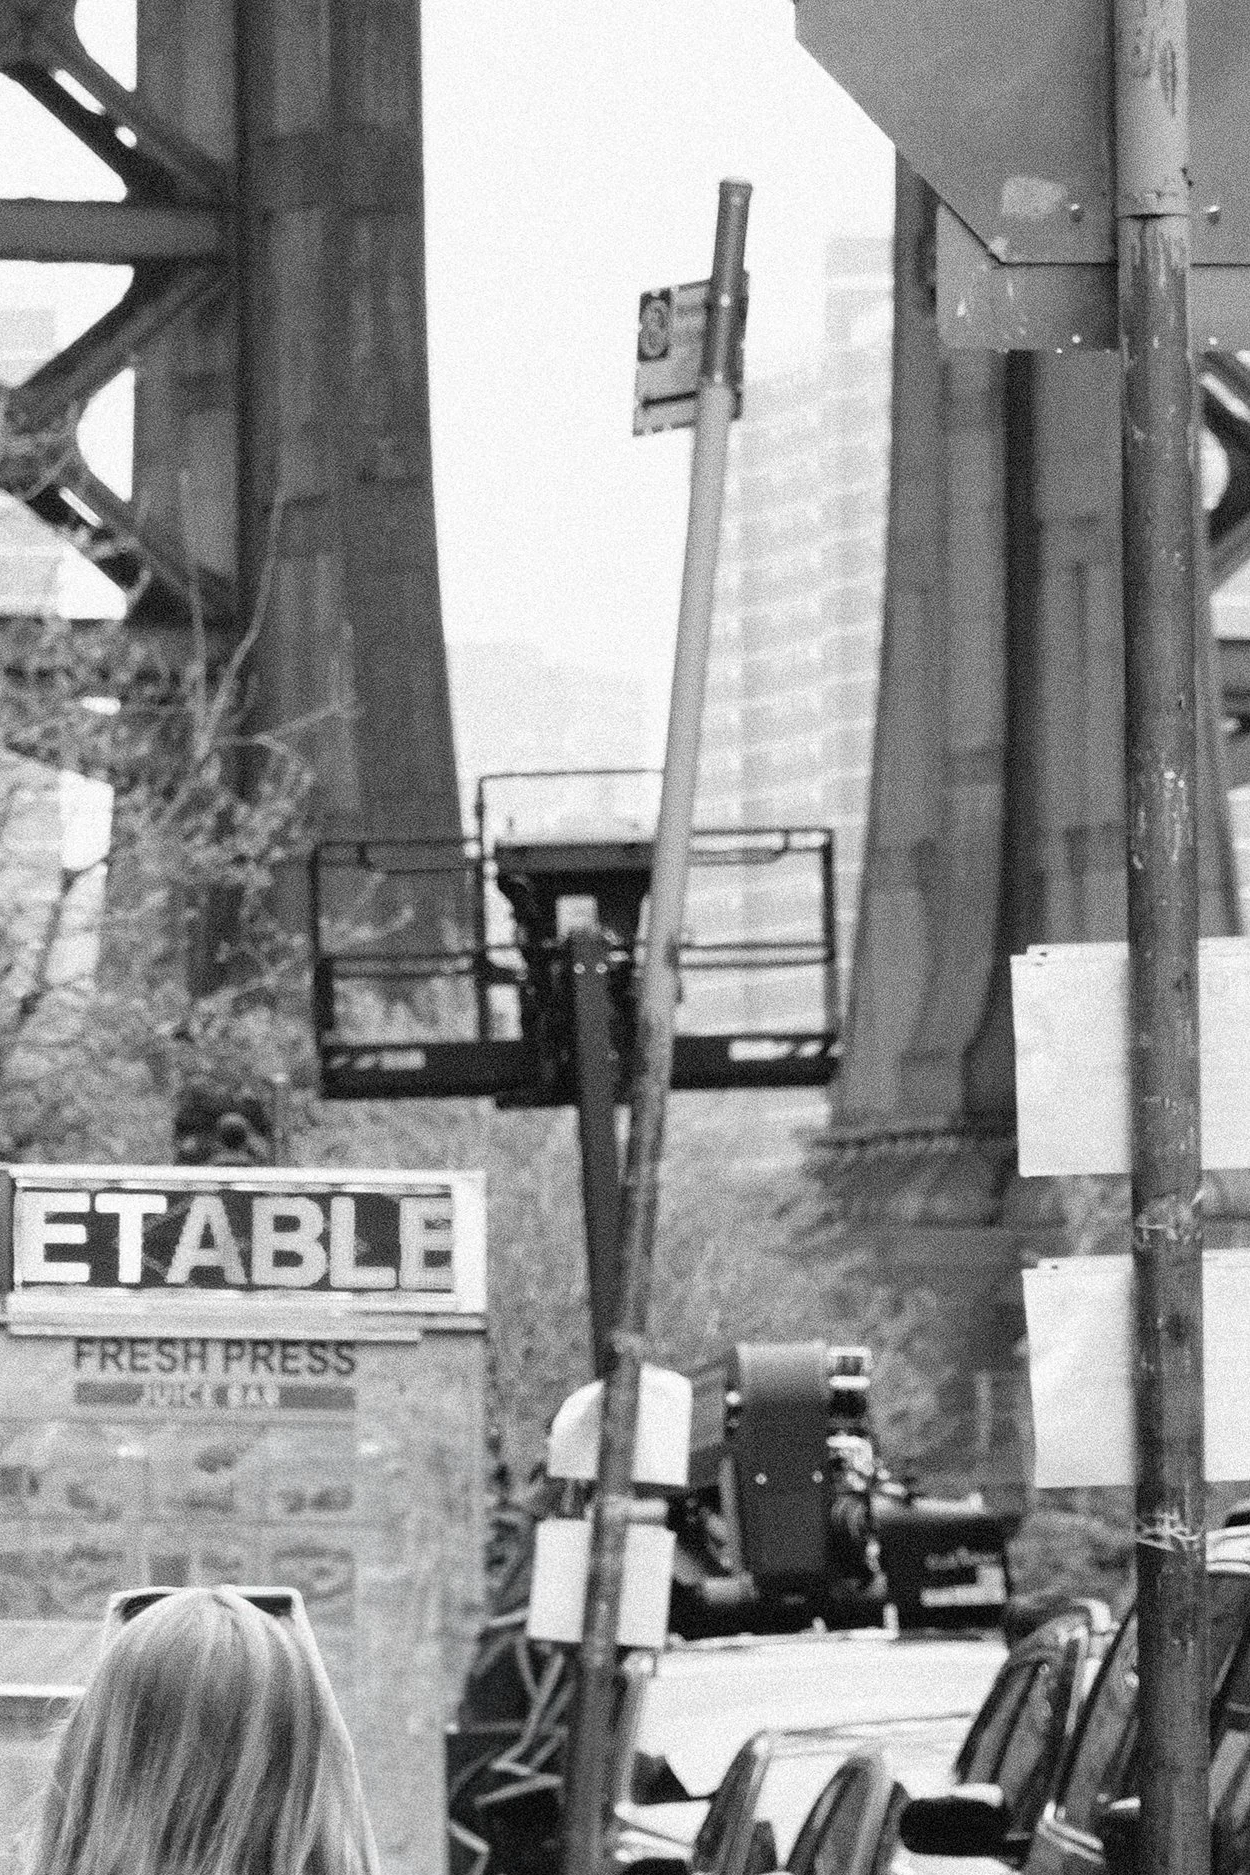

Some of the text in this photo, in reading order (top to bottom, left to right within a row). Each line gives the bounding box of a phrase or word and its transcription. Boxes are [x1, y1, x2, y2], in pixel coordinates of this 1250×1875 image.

[18, 1192, 452, 1289] ETABLE
[75, 1338, 357, 1377] FRESH PRESS
